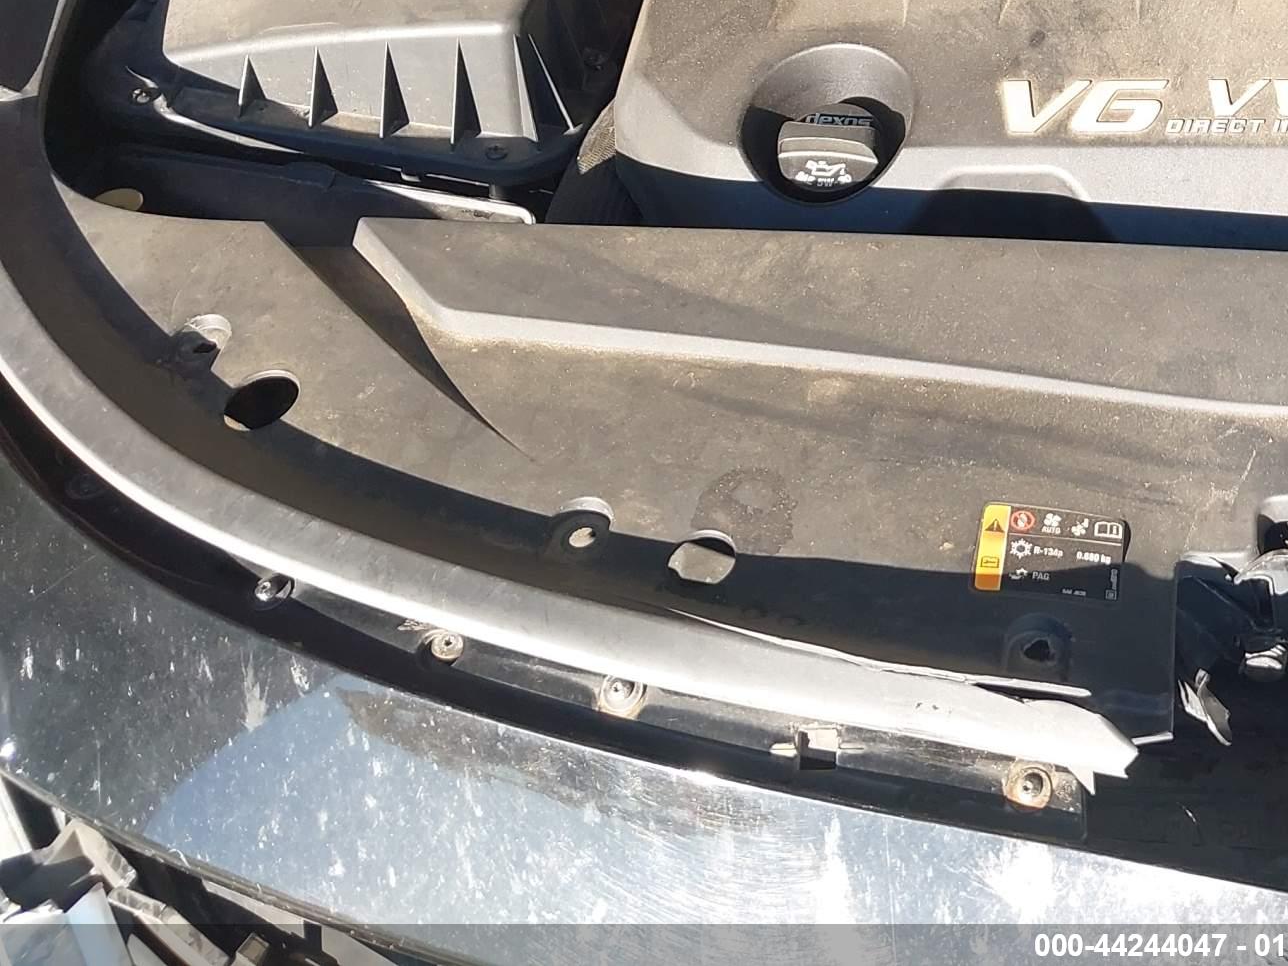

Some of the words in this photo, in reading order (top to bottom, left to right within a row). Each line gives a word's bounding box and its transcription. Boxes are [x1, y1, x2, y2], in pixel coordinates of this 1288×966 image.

[1001, 78, 1169, 134] V6
[1166, 118, 1267, 134] DIRECT
[1041, 525, 1061, 535] AUTO
[1031, 571, 1050, 581] PAG
